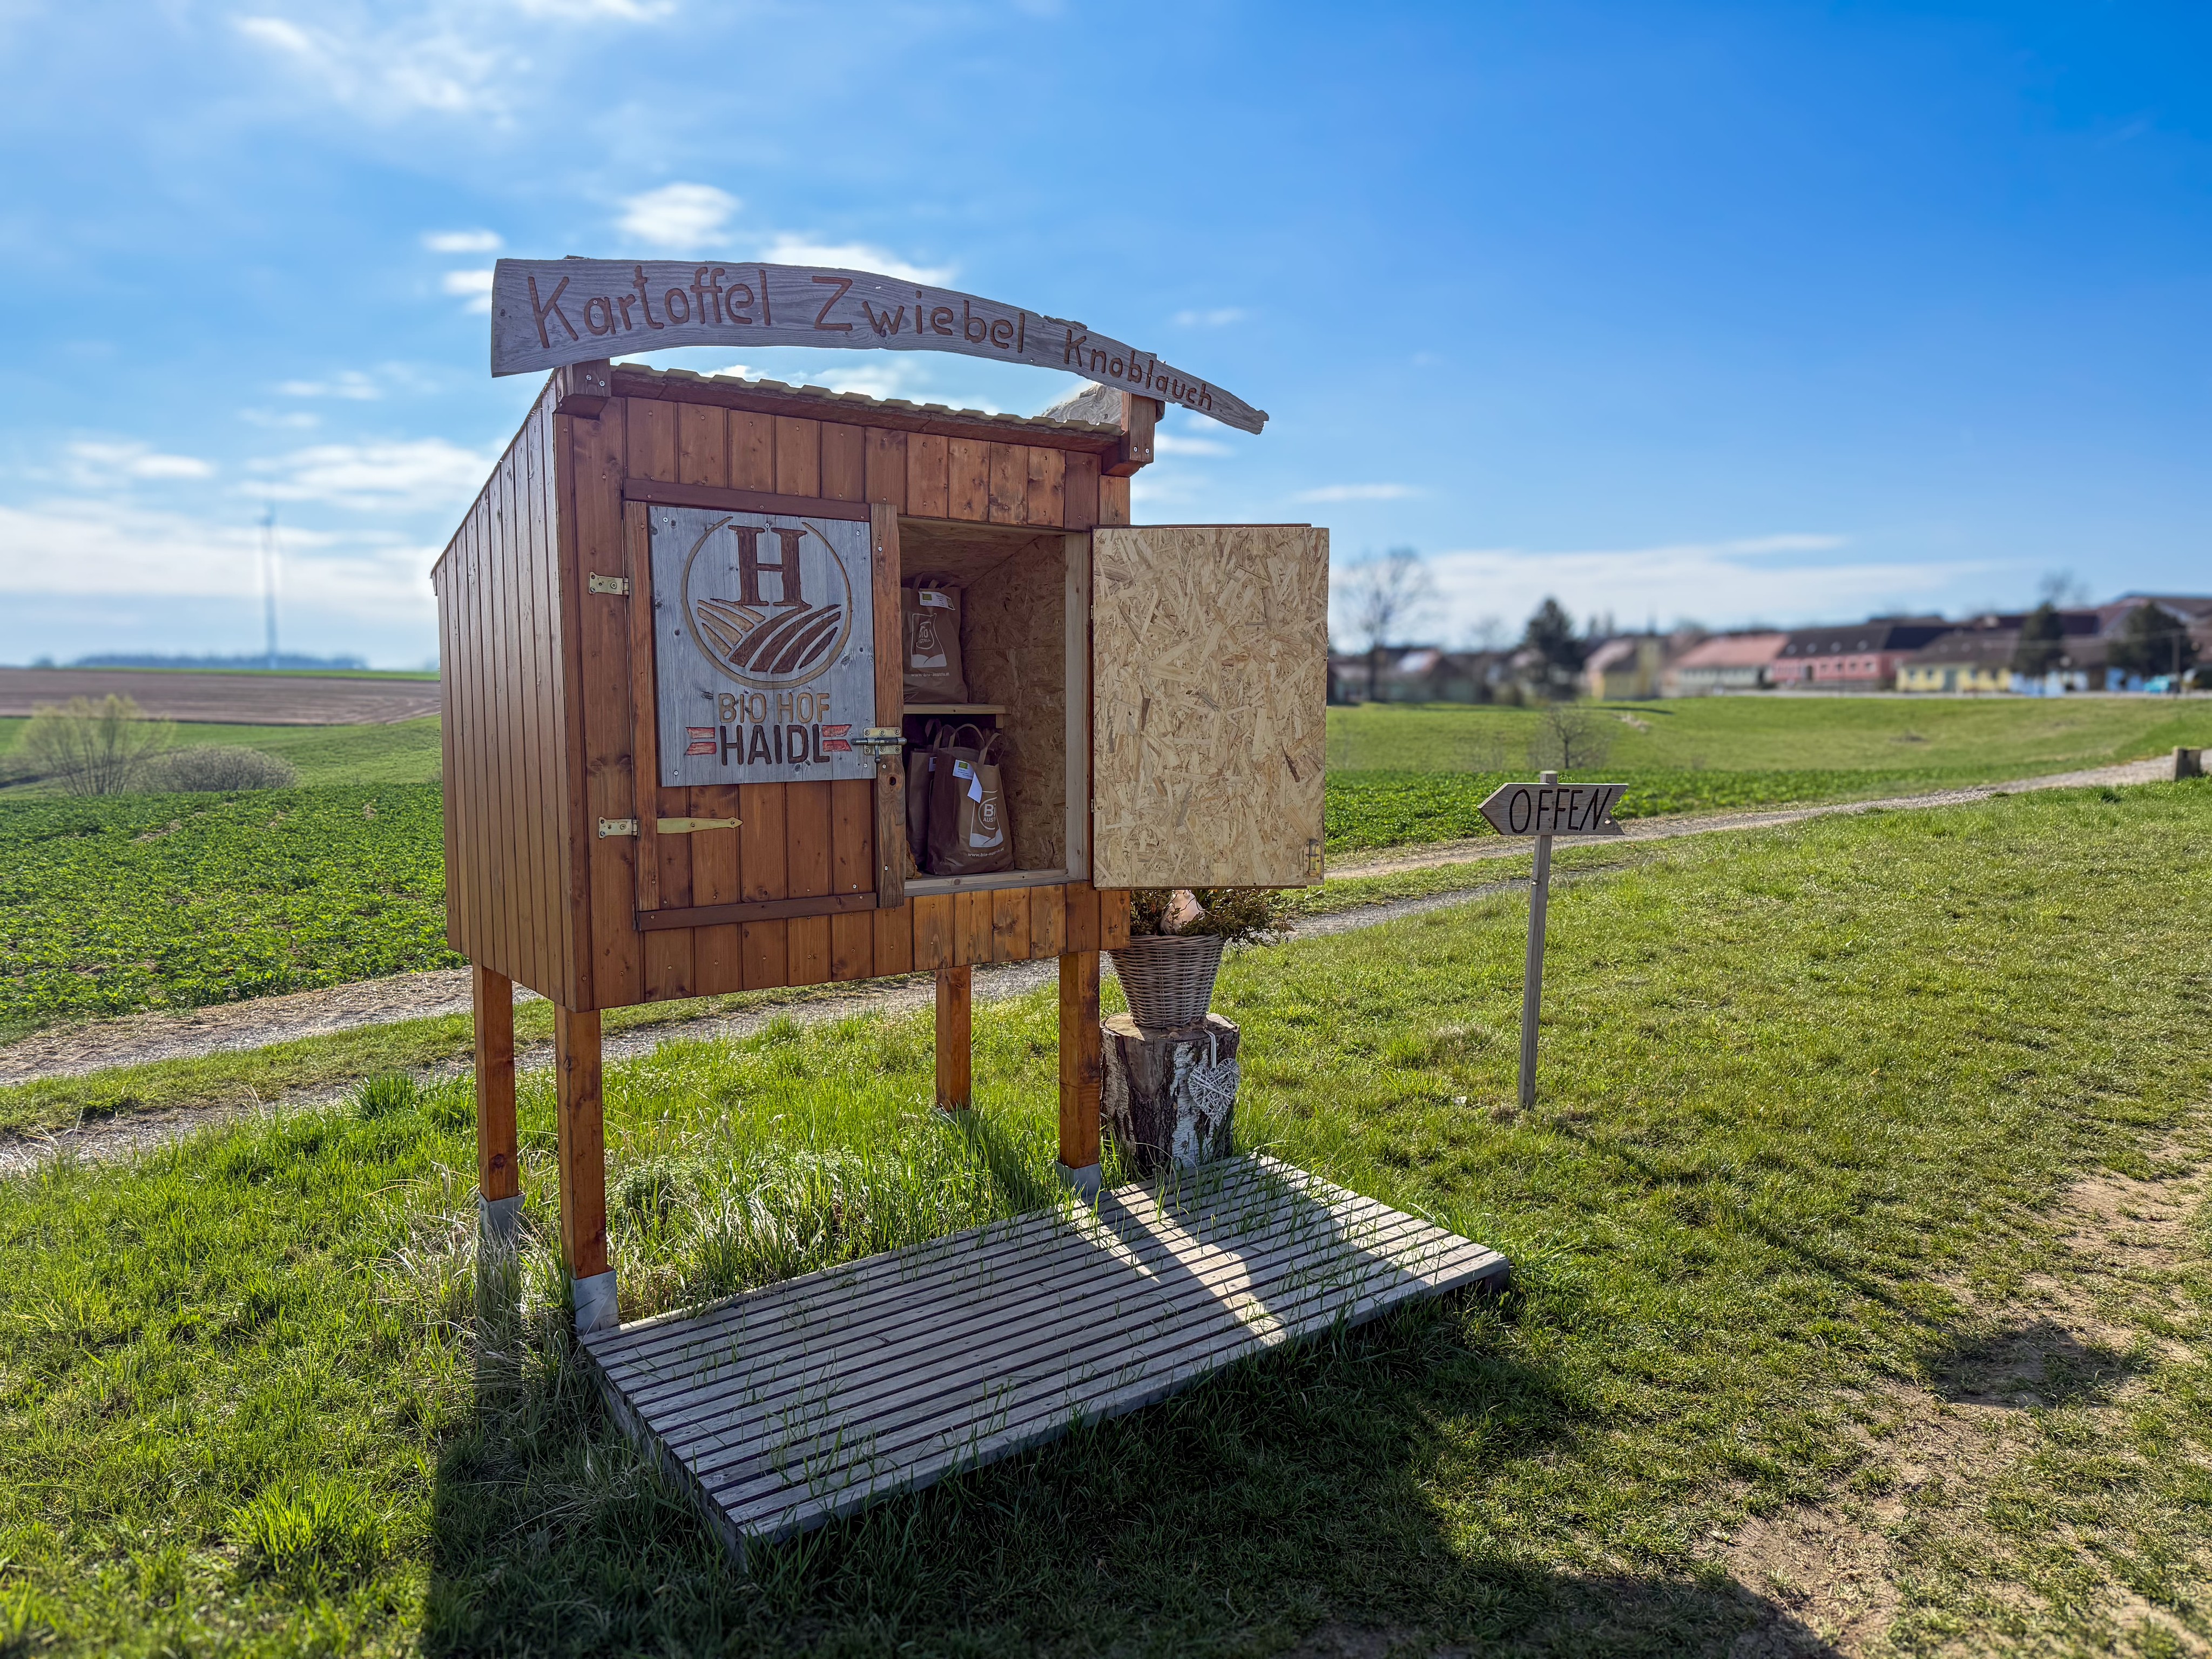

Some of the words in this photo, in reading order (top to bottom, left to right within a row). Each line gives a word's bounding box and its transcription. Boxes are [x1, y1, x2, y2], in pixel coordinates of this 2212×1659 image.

[527, 265, 771, 348] Kartoffel
[812, 275, 1025, 353] Zwiebel
[1063, 329, 1212, 411] Knoblauch
[727, 524, 813, 609] H
[718, 692, 767, 724] BIO
[777, 692, 831, 724] HOF
[719, 724, 831, 766] HAIDL
[984, 804, 996, 817] Bi
[1509, 788, 1613, 834] OFFEN
